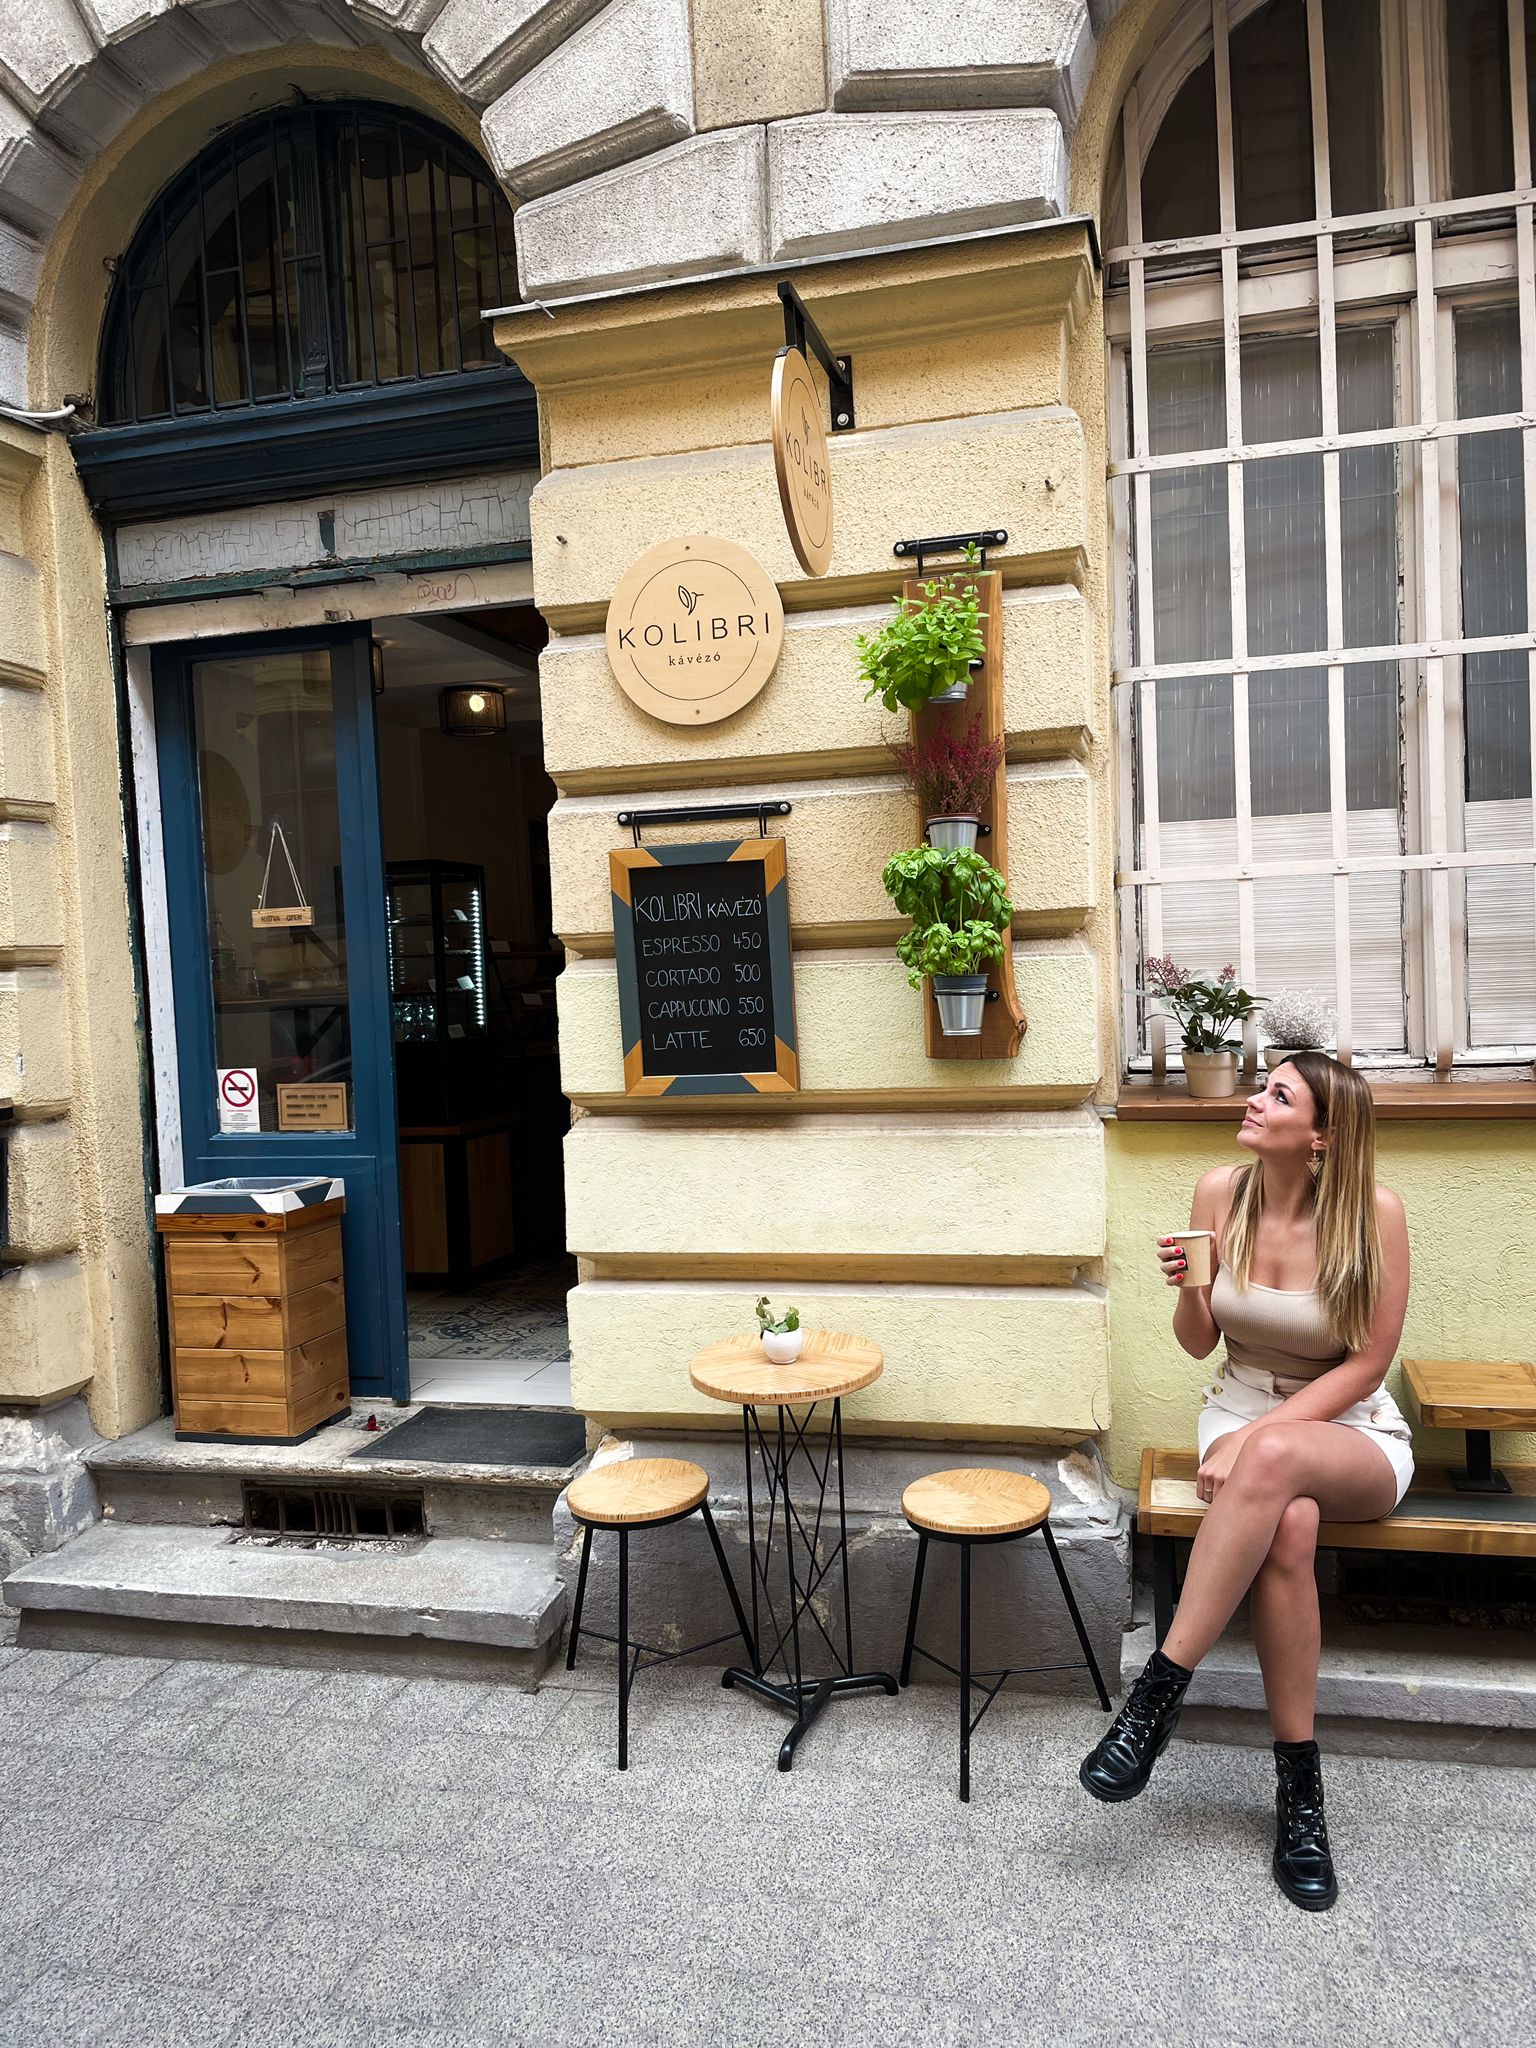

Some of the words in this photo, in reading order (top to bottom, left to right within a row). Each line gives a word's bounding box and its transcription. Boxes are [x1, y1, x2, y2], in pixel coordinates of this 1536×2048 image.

[785, 427, 831, 499] KOLIBRI
[618, 612, 770, 650] KOLIBRI
[668, 651, 721, 666] kávézó
[633, 892, 702, 923] KOLIBRI
[706, 893, 762, 918] KÁVÉZÓ
[642, 934, 720, 957] ESPRESSO
[733, 931, 762, 949] 450
[645, 966, 721, 988] CORTADO
[734, 963, 761, 983] 500
[648, 997, 730, 1019] CAPPUCCINO
[738, 996, 764, 1015] 550
[652, 1030, 713, 1051] LATTE
[738, 1027, 767, 1047] 650
